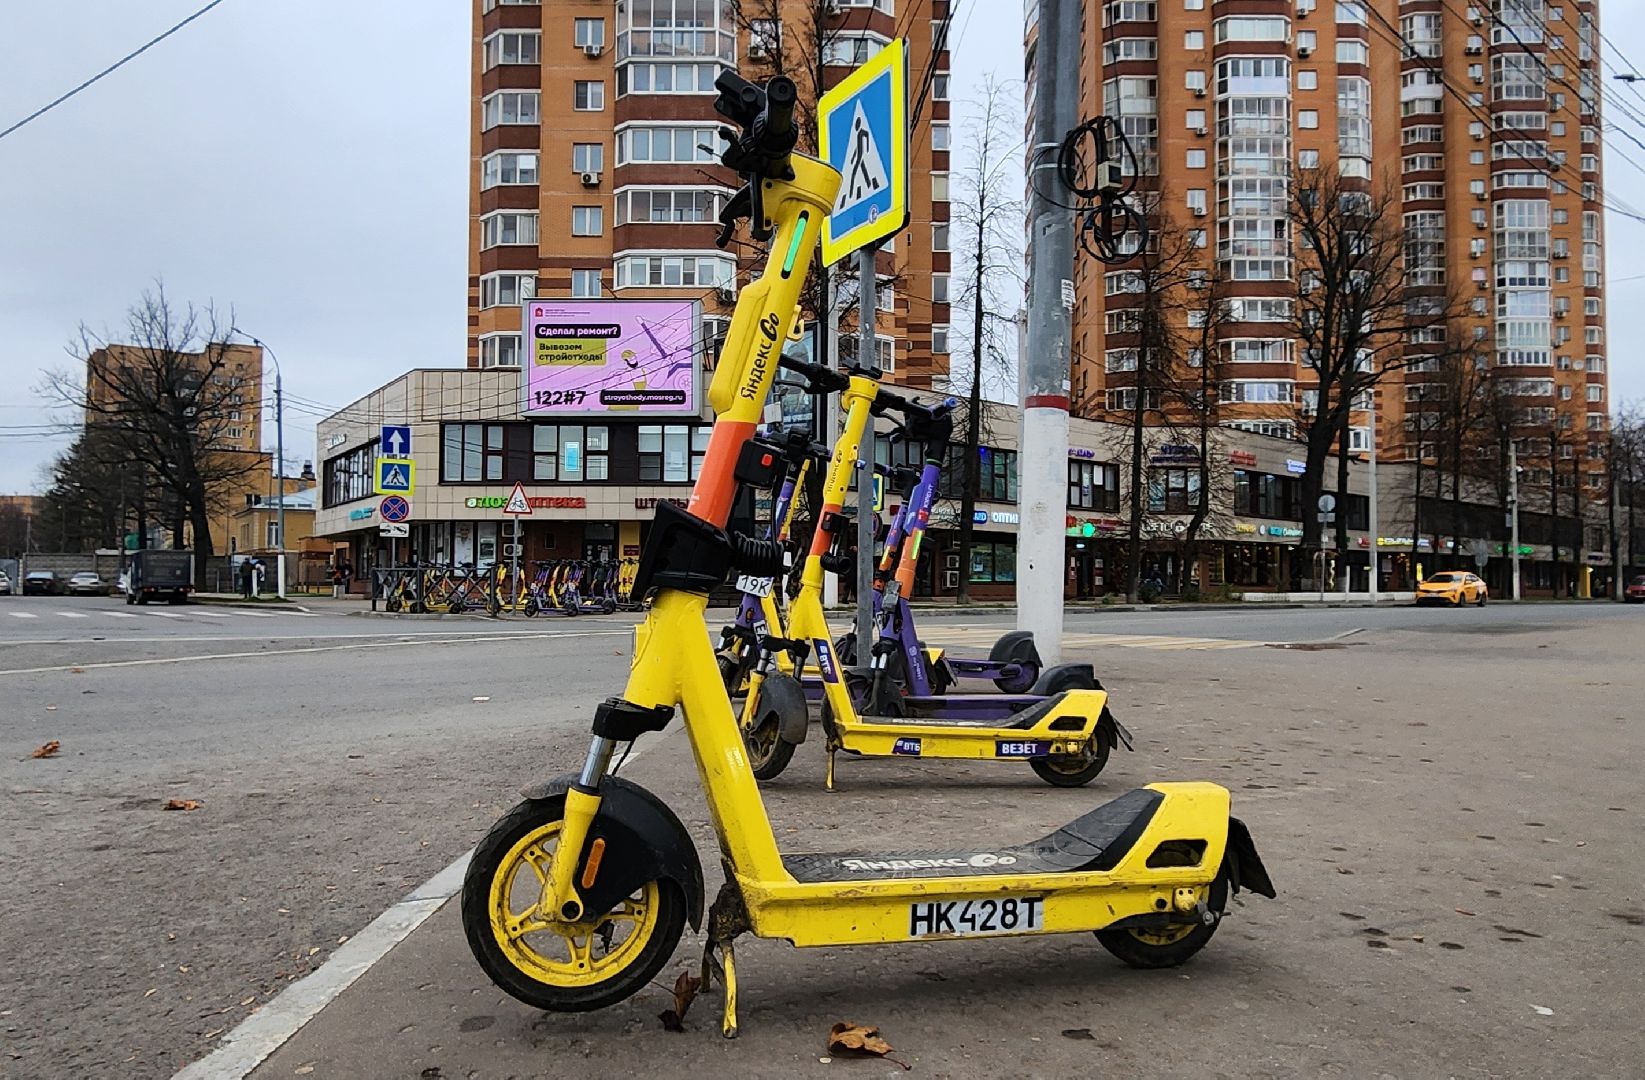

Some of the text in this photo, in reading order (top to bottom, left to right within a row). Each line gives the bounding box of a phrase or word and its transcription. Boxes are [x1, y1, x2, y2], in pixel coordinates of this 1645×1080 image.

[538, 326, 618, 337] Сделал ремонт?
[538, 352, 603, 362] стройотходы
[740, 312, 780, 401] Яндекс Go
[534, 390, 587, 405] 122#7
[529, 496, 586, 509] птека
[634, 497, 690, 509] ШТРЫ
[992, 511, 1019, 524] ОПТИ
[903, 742, 921, 752] ВТБ
[1001, 741, 1038, 754] ВЕЗЁТ
[841, 853, 1018, 872] Яндекс Go
